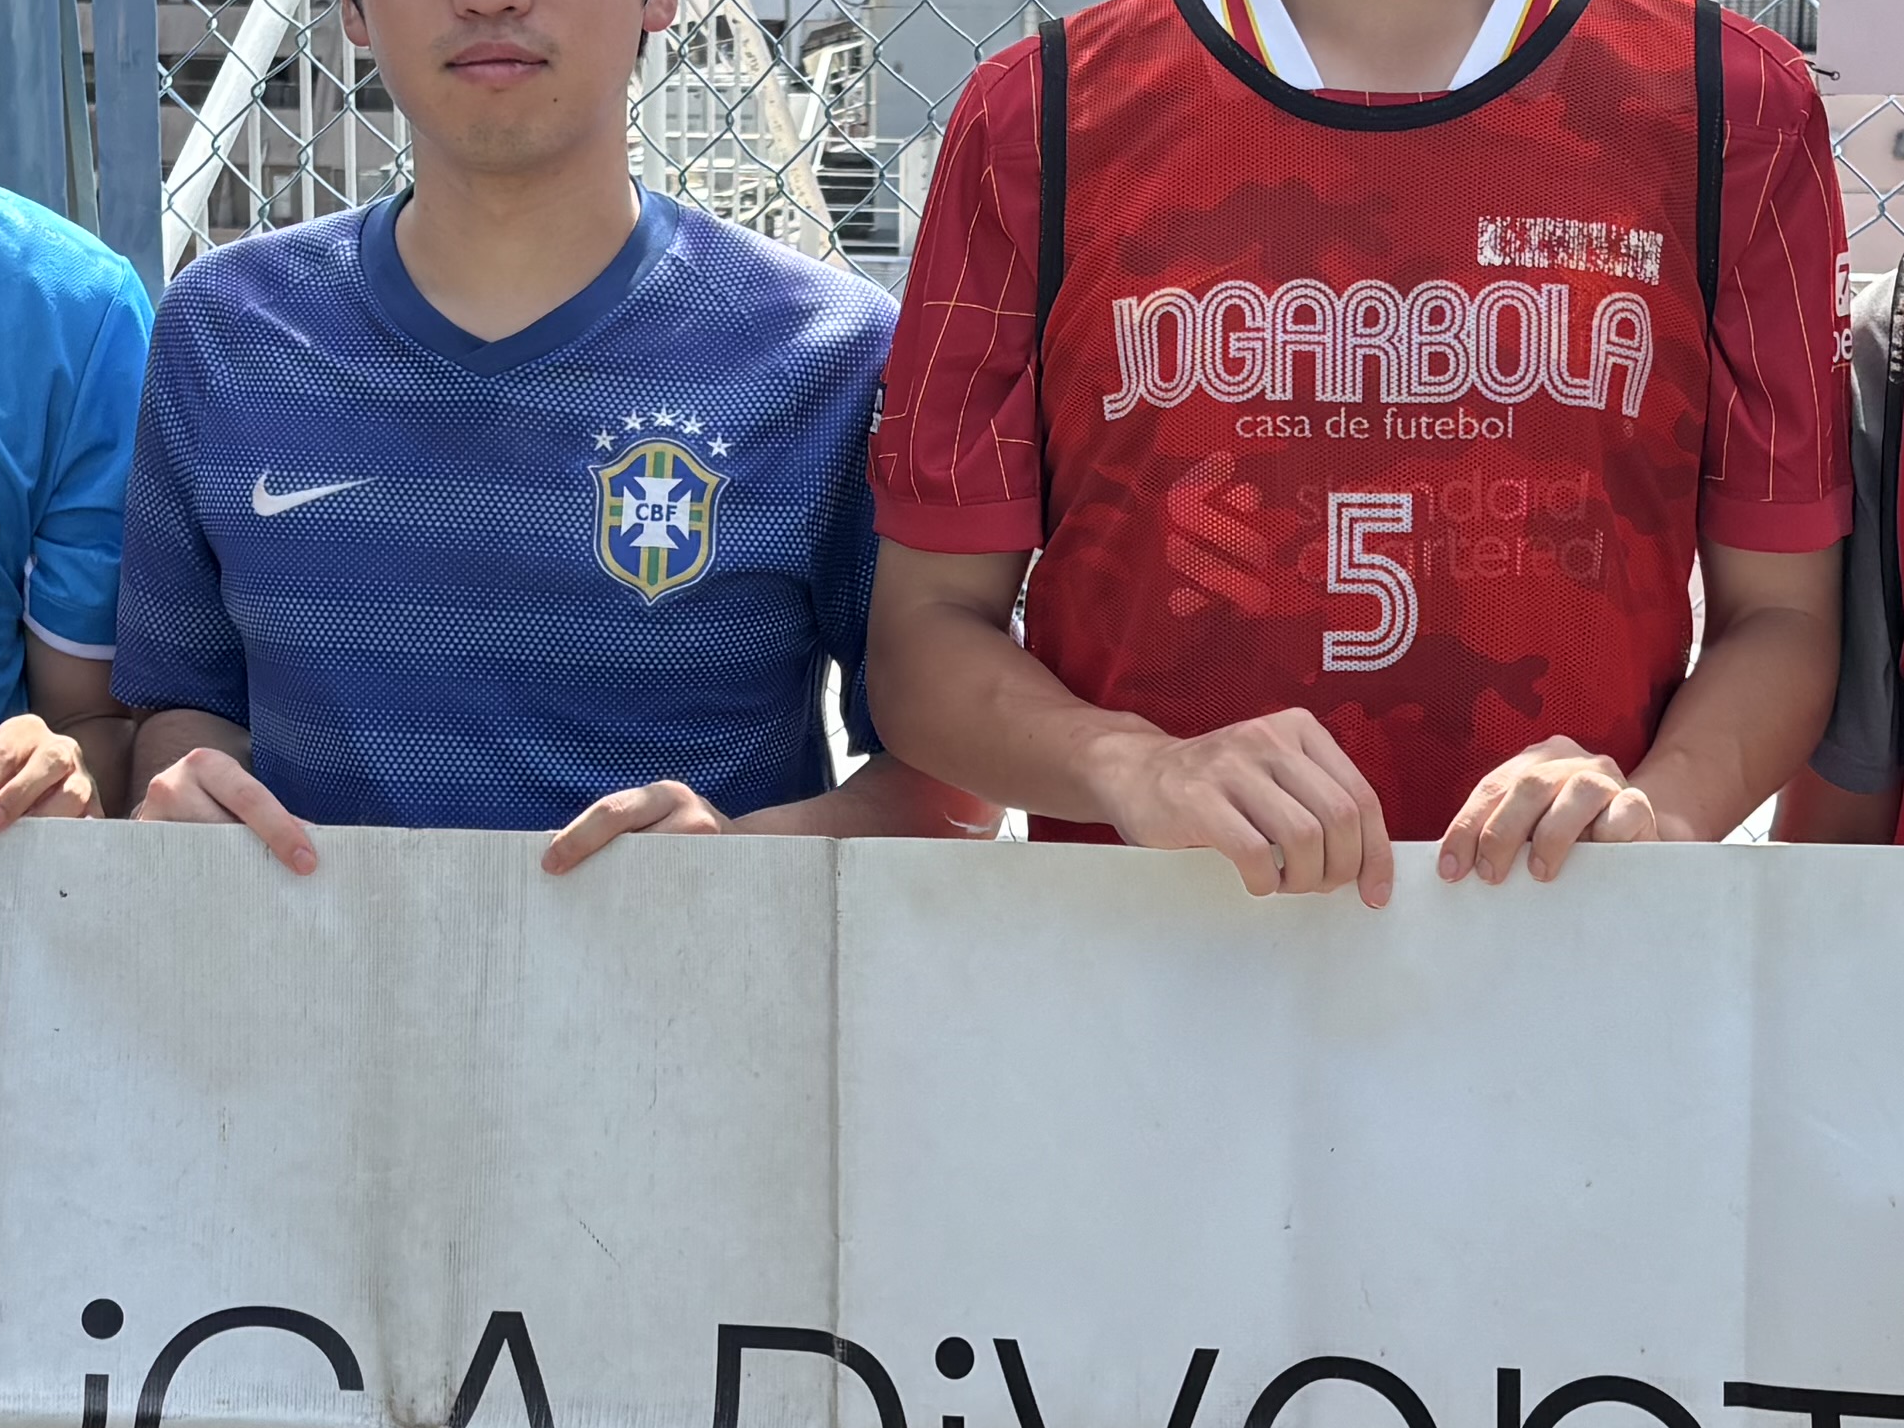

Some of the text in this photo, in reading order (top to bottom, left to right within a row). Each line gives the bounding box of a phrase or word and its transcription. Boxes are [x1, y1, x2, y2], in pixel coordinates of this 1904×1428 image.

[1103, 278, 1654, 421] JOGARBOLA
[1235, 407, 1513, 439] casa de futebol
[635, 503, 678, 522] CBF
[1323, 491, 1418, 672] 5
